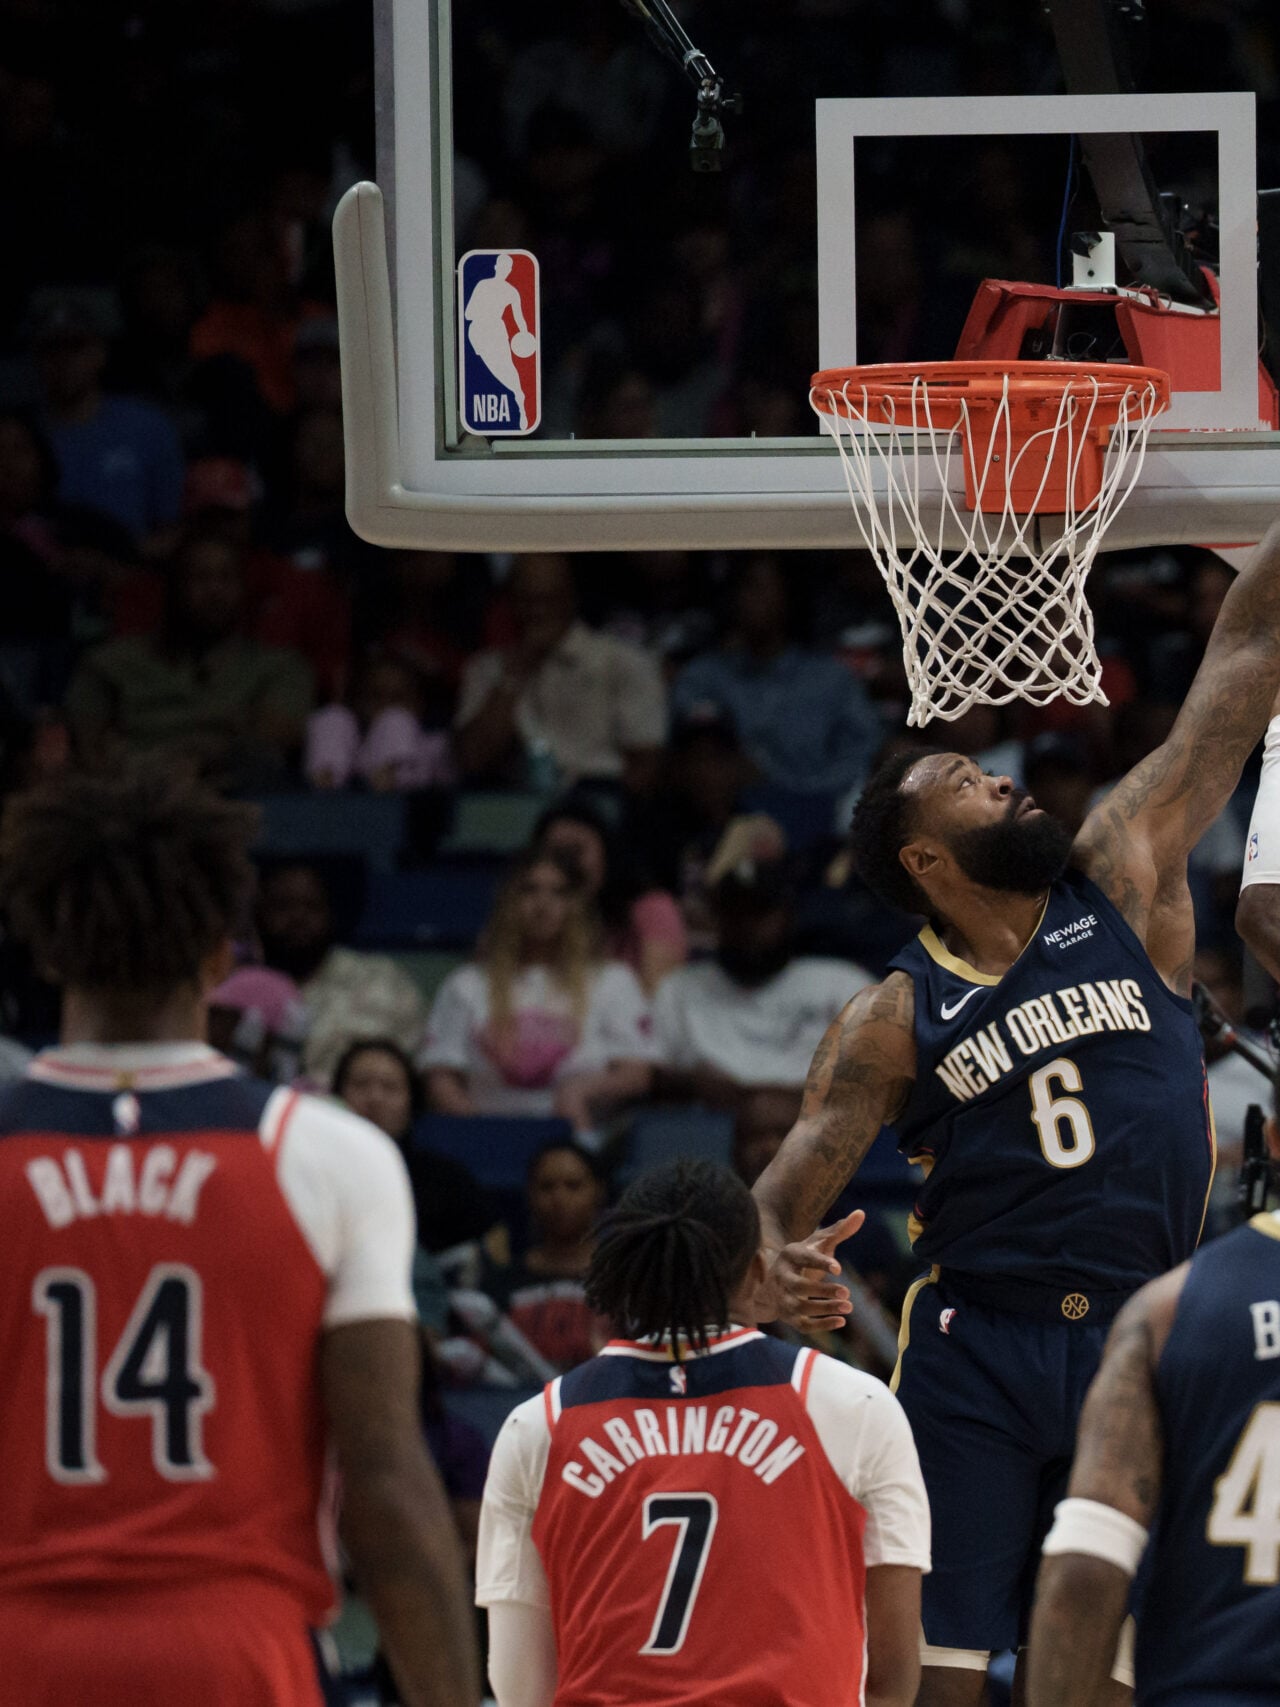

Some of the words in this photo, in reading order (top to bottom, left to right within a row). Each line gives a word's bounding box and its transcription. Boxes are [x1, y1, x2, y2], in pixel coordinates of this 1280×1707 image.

[473, 394, 511, 423] NBA
[1043, 914, 1098, 946] NEWAGE
[1059, 929, 1094, 949] GARAGE
[934, 1021, 1014, 1103] NEW
[1005, 978, 1151, 1055] ORLEANS
[1028, 1057, 1096, 1169] 6
[24, 1143, 217, 1230] BLACK
[31, 1263, 216, 1486] 14
[561, 1405, 806, 1498] CARRINGTON
[638, 1492, 718, 1656] 7
